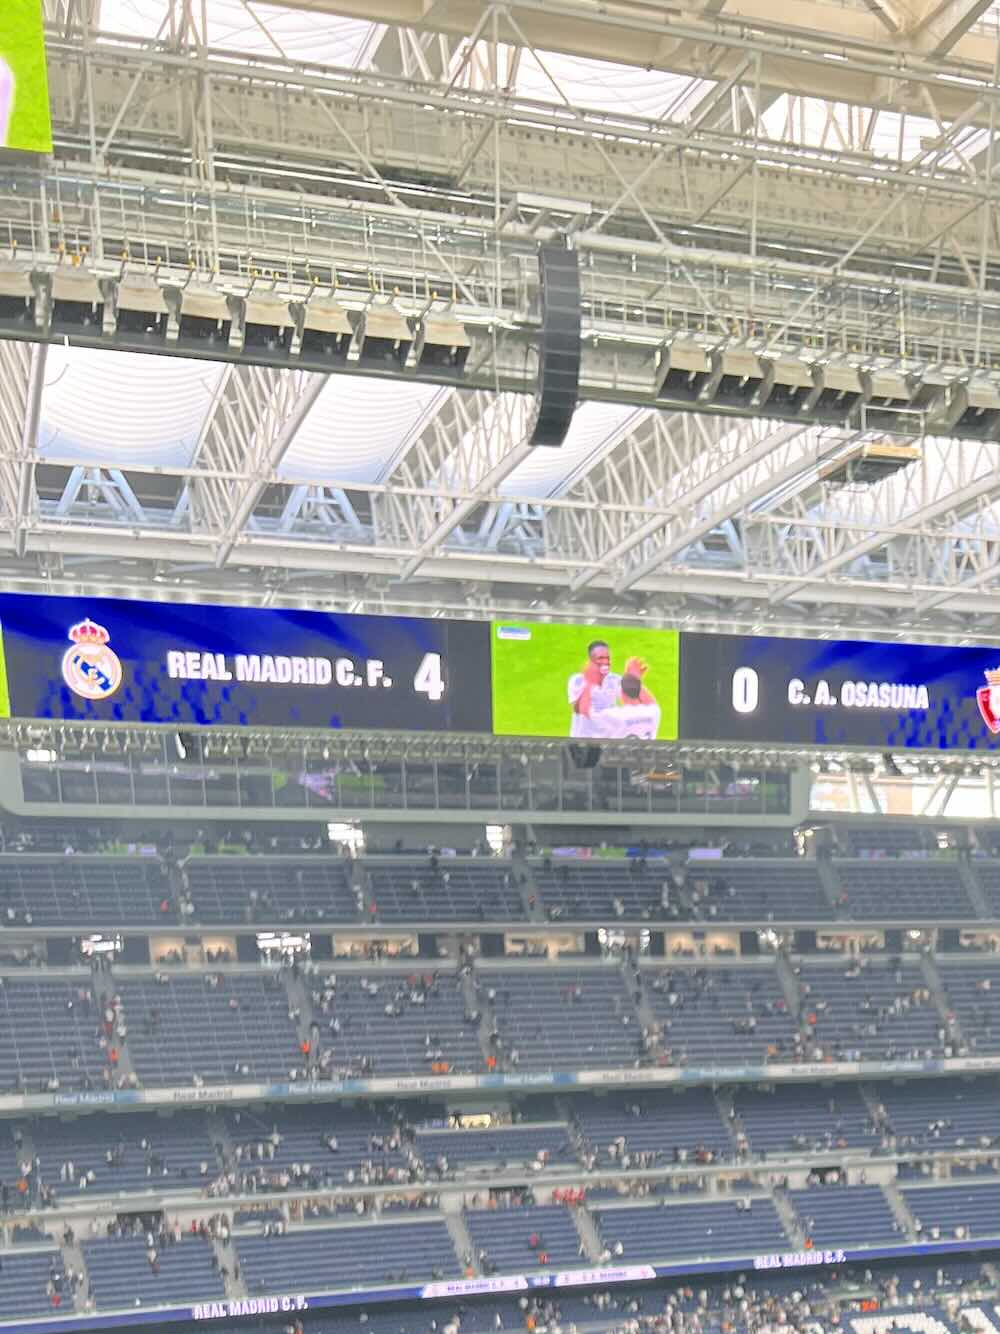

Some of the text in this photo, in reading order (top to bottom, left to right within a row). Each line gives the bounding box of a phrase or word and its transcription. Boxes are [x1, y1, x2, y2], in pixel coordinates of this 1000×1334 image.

[167, 650, 444, 700] REAL MADRID C. F. 4
[732, 667, 929, 713] 0 C. A. OSASUNA
[194, 1303, 226, 1320] REAL
[229, 1297, 278, 1317] MADRID
